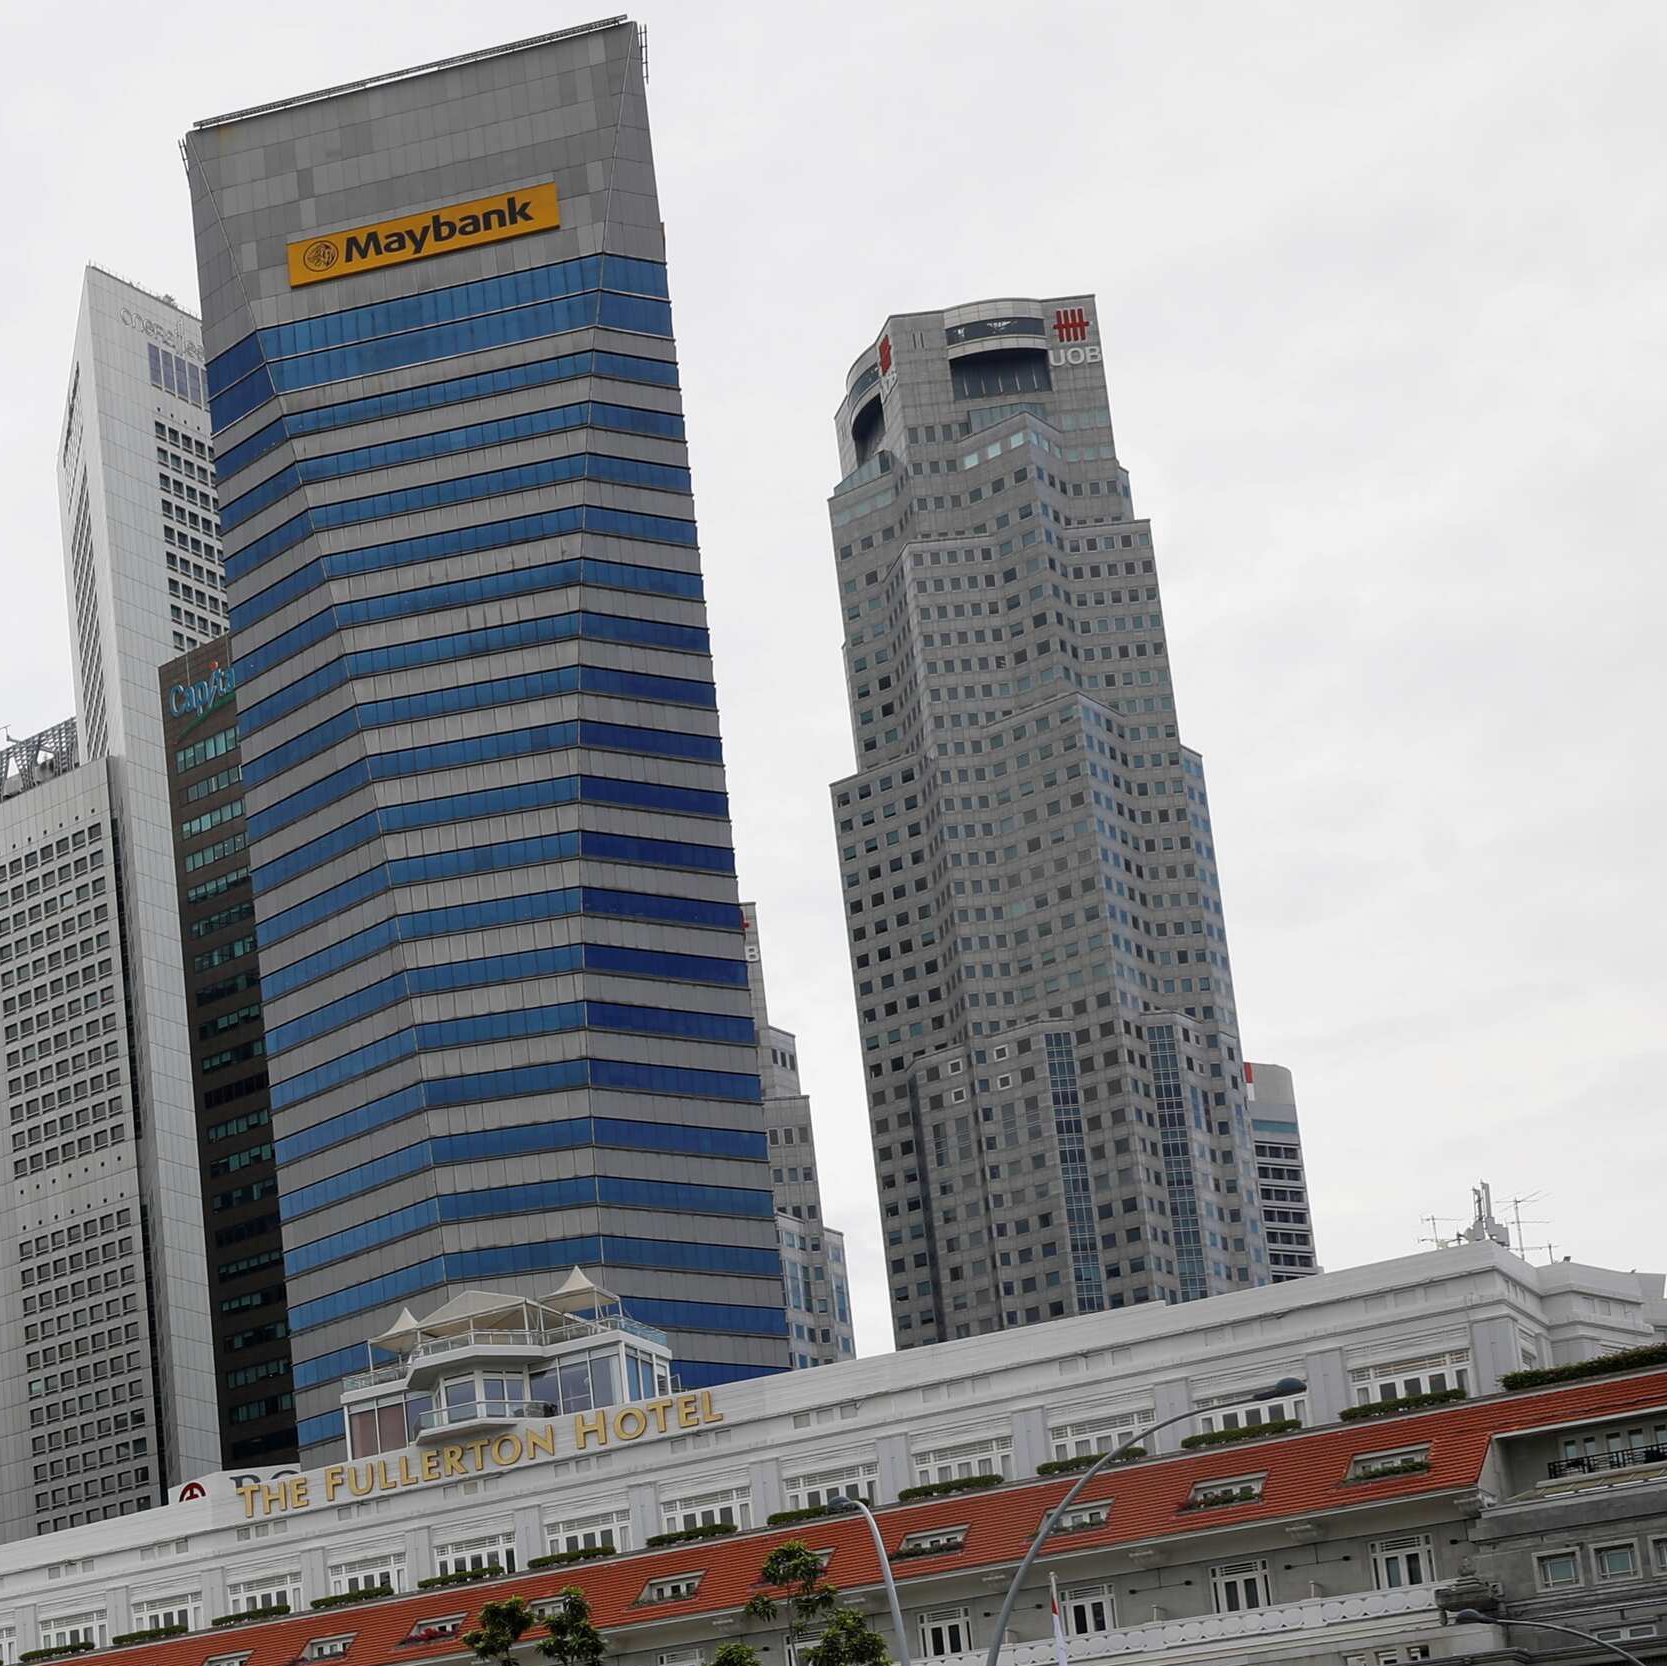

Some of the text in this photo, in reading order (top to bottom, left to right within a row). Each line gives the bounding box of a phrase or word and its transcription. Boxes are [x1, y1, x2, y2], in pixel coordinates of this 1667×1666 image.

[345, 197, 533, 263] Maybank
[1048, 346, 1101, 366] UOB
[236, 1390, 724, 1518] THE FULLERTON HOTEL
